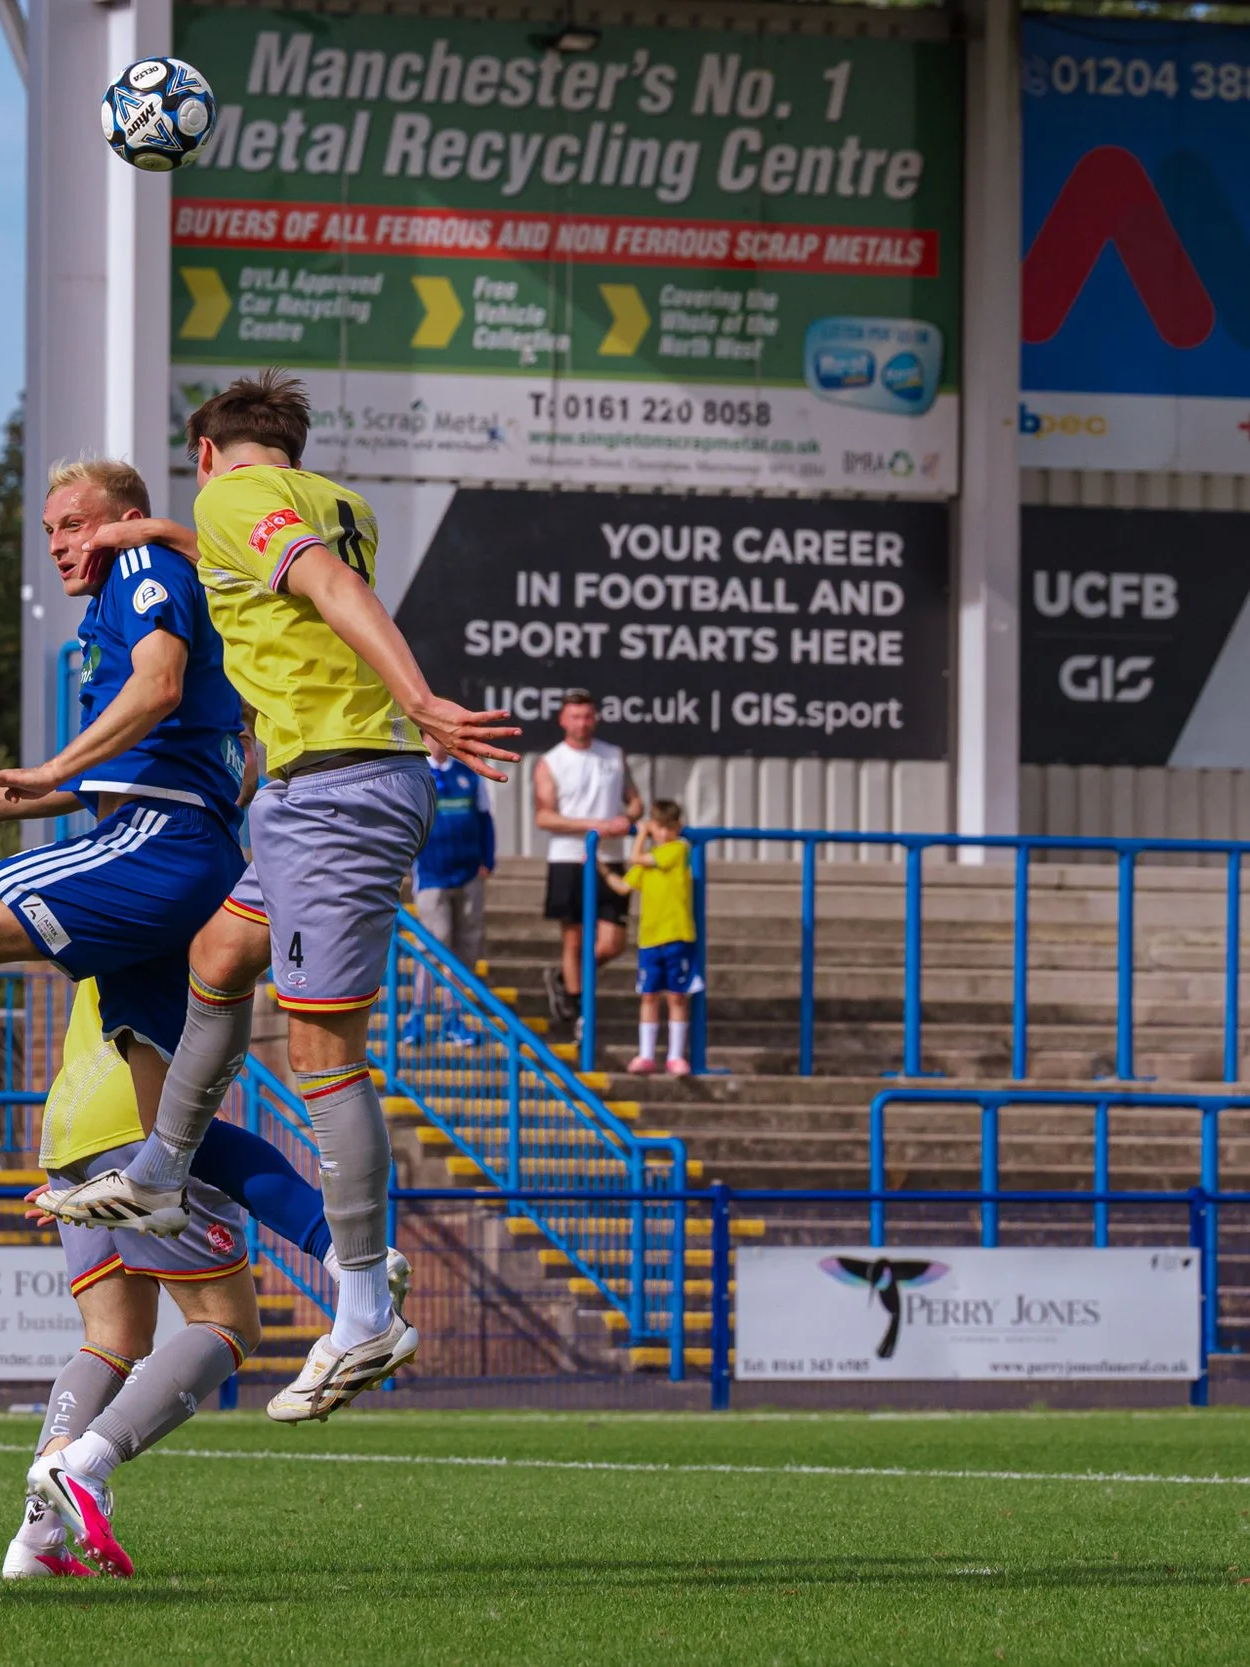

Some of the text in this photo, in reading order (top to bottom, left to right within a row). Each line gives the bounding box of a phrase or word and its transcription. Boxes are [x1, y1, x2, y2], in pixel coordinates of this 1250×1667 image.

[133, 65, 159, 82] DELTA
[247, 30, 852, 122] Manchester's No. 1
[1052, 55, 1250, 101] 01204 38
[383, 115, 700, 203] Recycling
[717, 127, 924, 200] Centre
[175, 206, 925, 267] BUYERS OF ALL FERROUS AND NON FERROUS SCRAP METALS
[292, 268, 384, 298] Approved
[658, 284, 779, 312] Covering the
[238, 291, 372, 324] Car Recycling
[659, 309, 779, 336] Whole of the
[237, 316, 305, 341] Centre
[657, 335, 765, 361] North West
[363, 406, 428, 435] Scrap
[562, 394, 629, 422] 0161
[642, 396, 693, 425] 220
[702, 399, 772, 428] 8058
[602, 523, 903, 567] YOUR CAREER
[516, 571, 904, 617] IN FOOTBALL AND
[1033, 570, 1179, 620] UCFB
[464, 620, 903, 665] SPORT STARTS HERE
[1058, 654, 1155, 703] GIS
[484, 685, 700, 726] UCF.ac.uk
[732, 693, 903, 735] GIS.sport
[289, 931, 304, 968] 4
[17, 1311, 83, 1331] busin
[905, 1293, 1100, 1328] PERRY JONES
